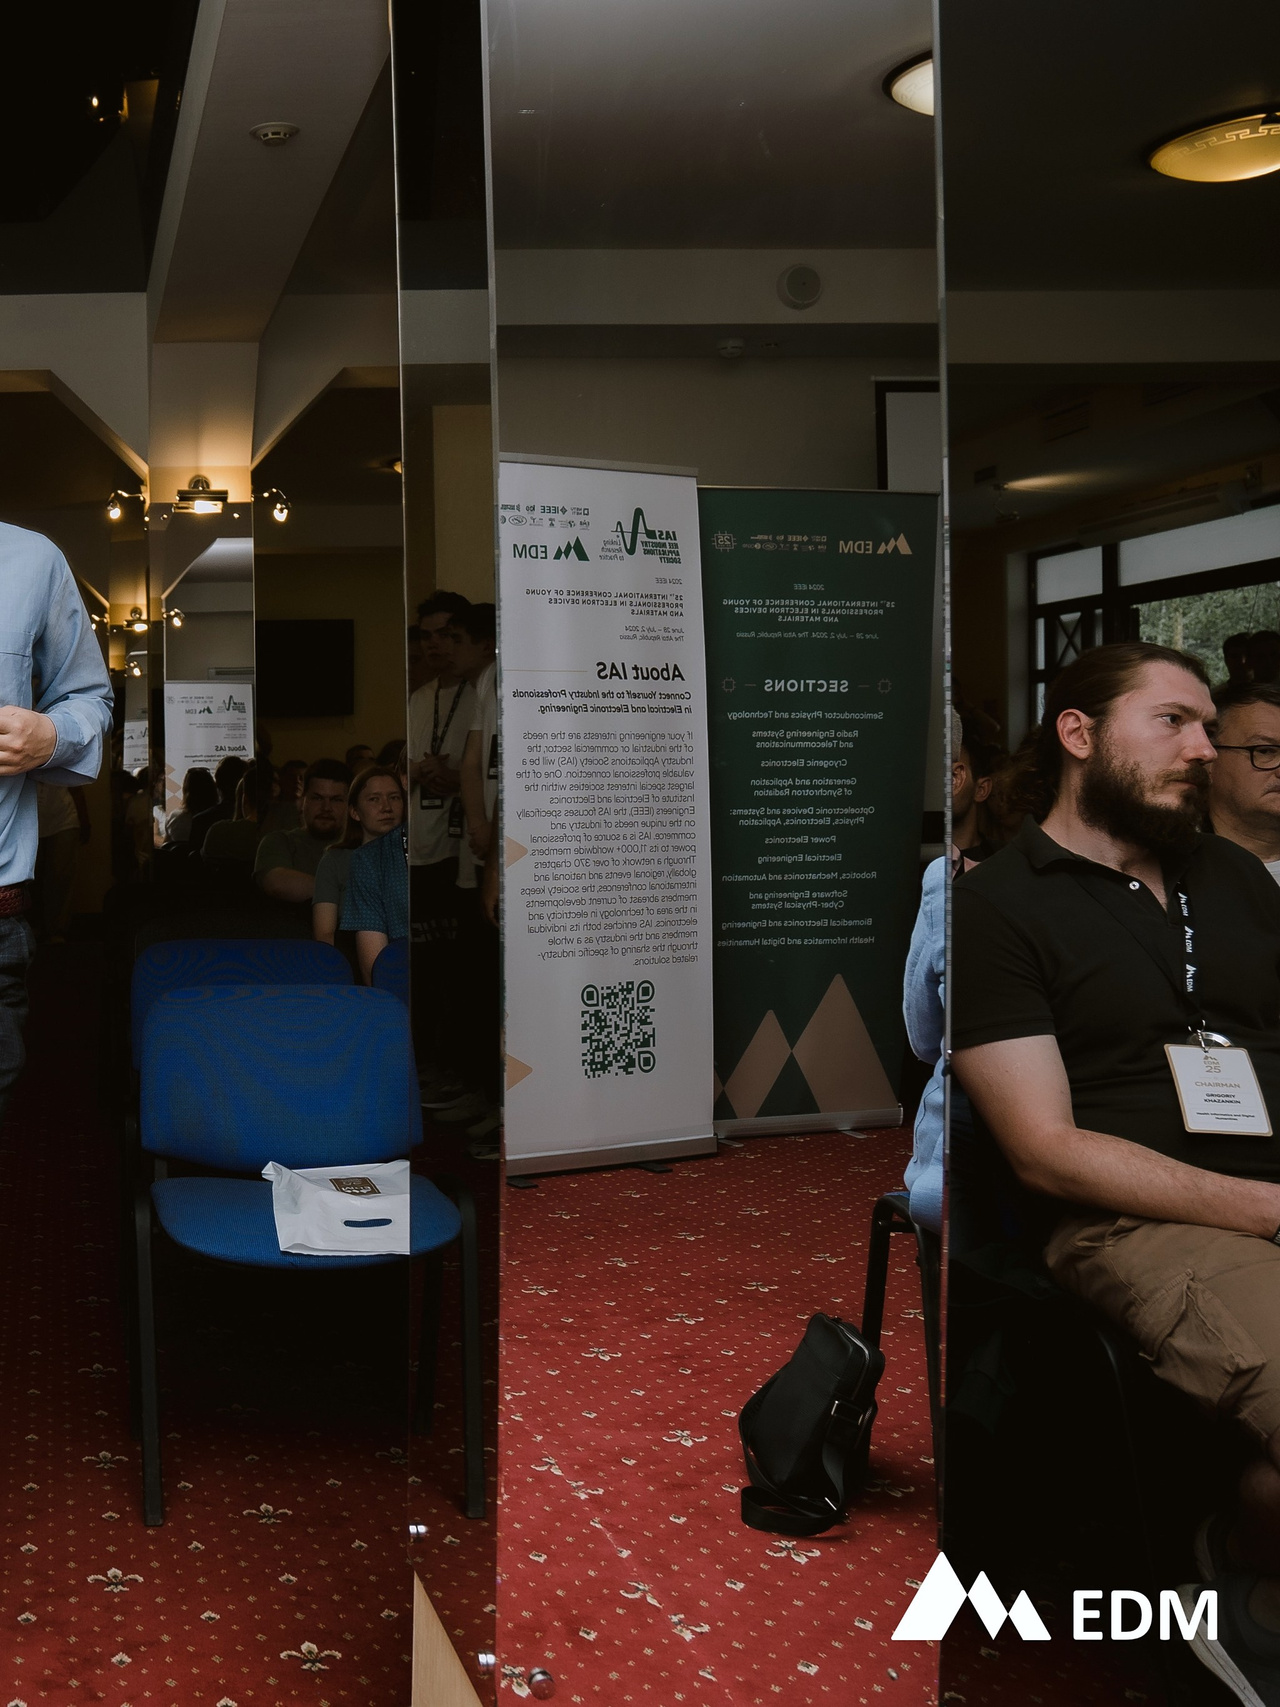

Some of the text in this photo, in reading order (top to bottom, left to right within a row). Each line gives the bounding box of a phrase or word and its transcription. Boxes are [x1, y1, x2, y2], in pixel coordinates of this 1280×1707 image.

[1185, 939, 1193, 953] EDM
[1186, 979, 1194, 993] EDM
[1195, 1081, 1240, 1089] CHAIRMAN
